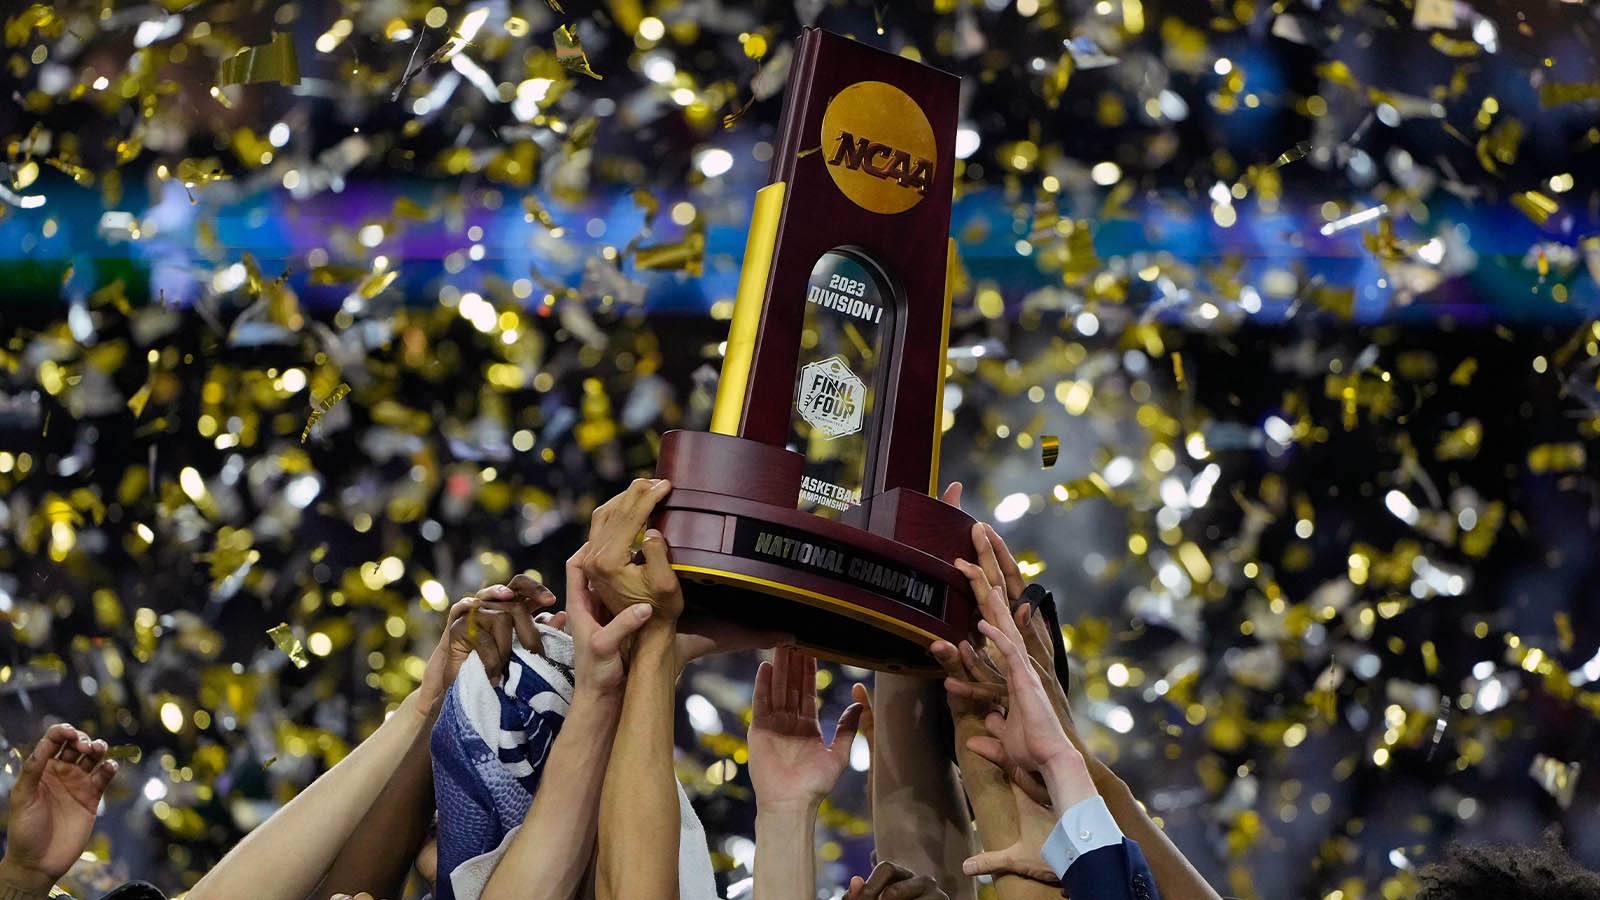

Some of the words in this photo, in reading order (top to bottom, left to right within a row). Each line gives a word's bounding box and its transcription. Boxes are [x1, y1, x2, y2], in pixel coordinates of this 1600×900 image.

[828, 131, 933, 195] NCAA
[829, 274, 866, 297] 2023
[808, 286, 875, 321] DIVISION
[874, 307, 883, 323] I
[811, 374, 854, 402] FINAL
[813, 395, 855, 419] FOUR
[799, 489, 849, 512] AMPIONSHIP
[800, 475, 861, 506] ASKETBALL
[755, 532, 844, 574] NATIONAL
[849, 558, 934, 606] CHAMPION
